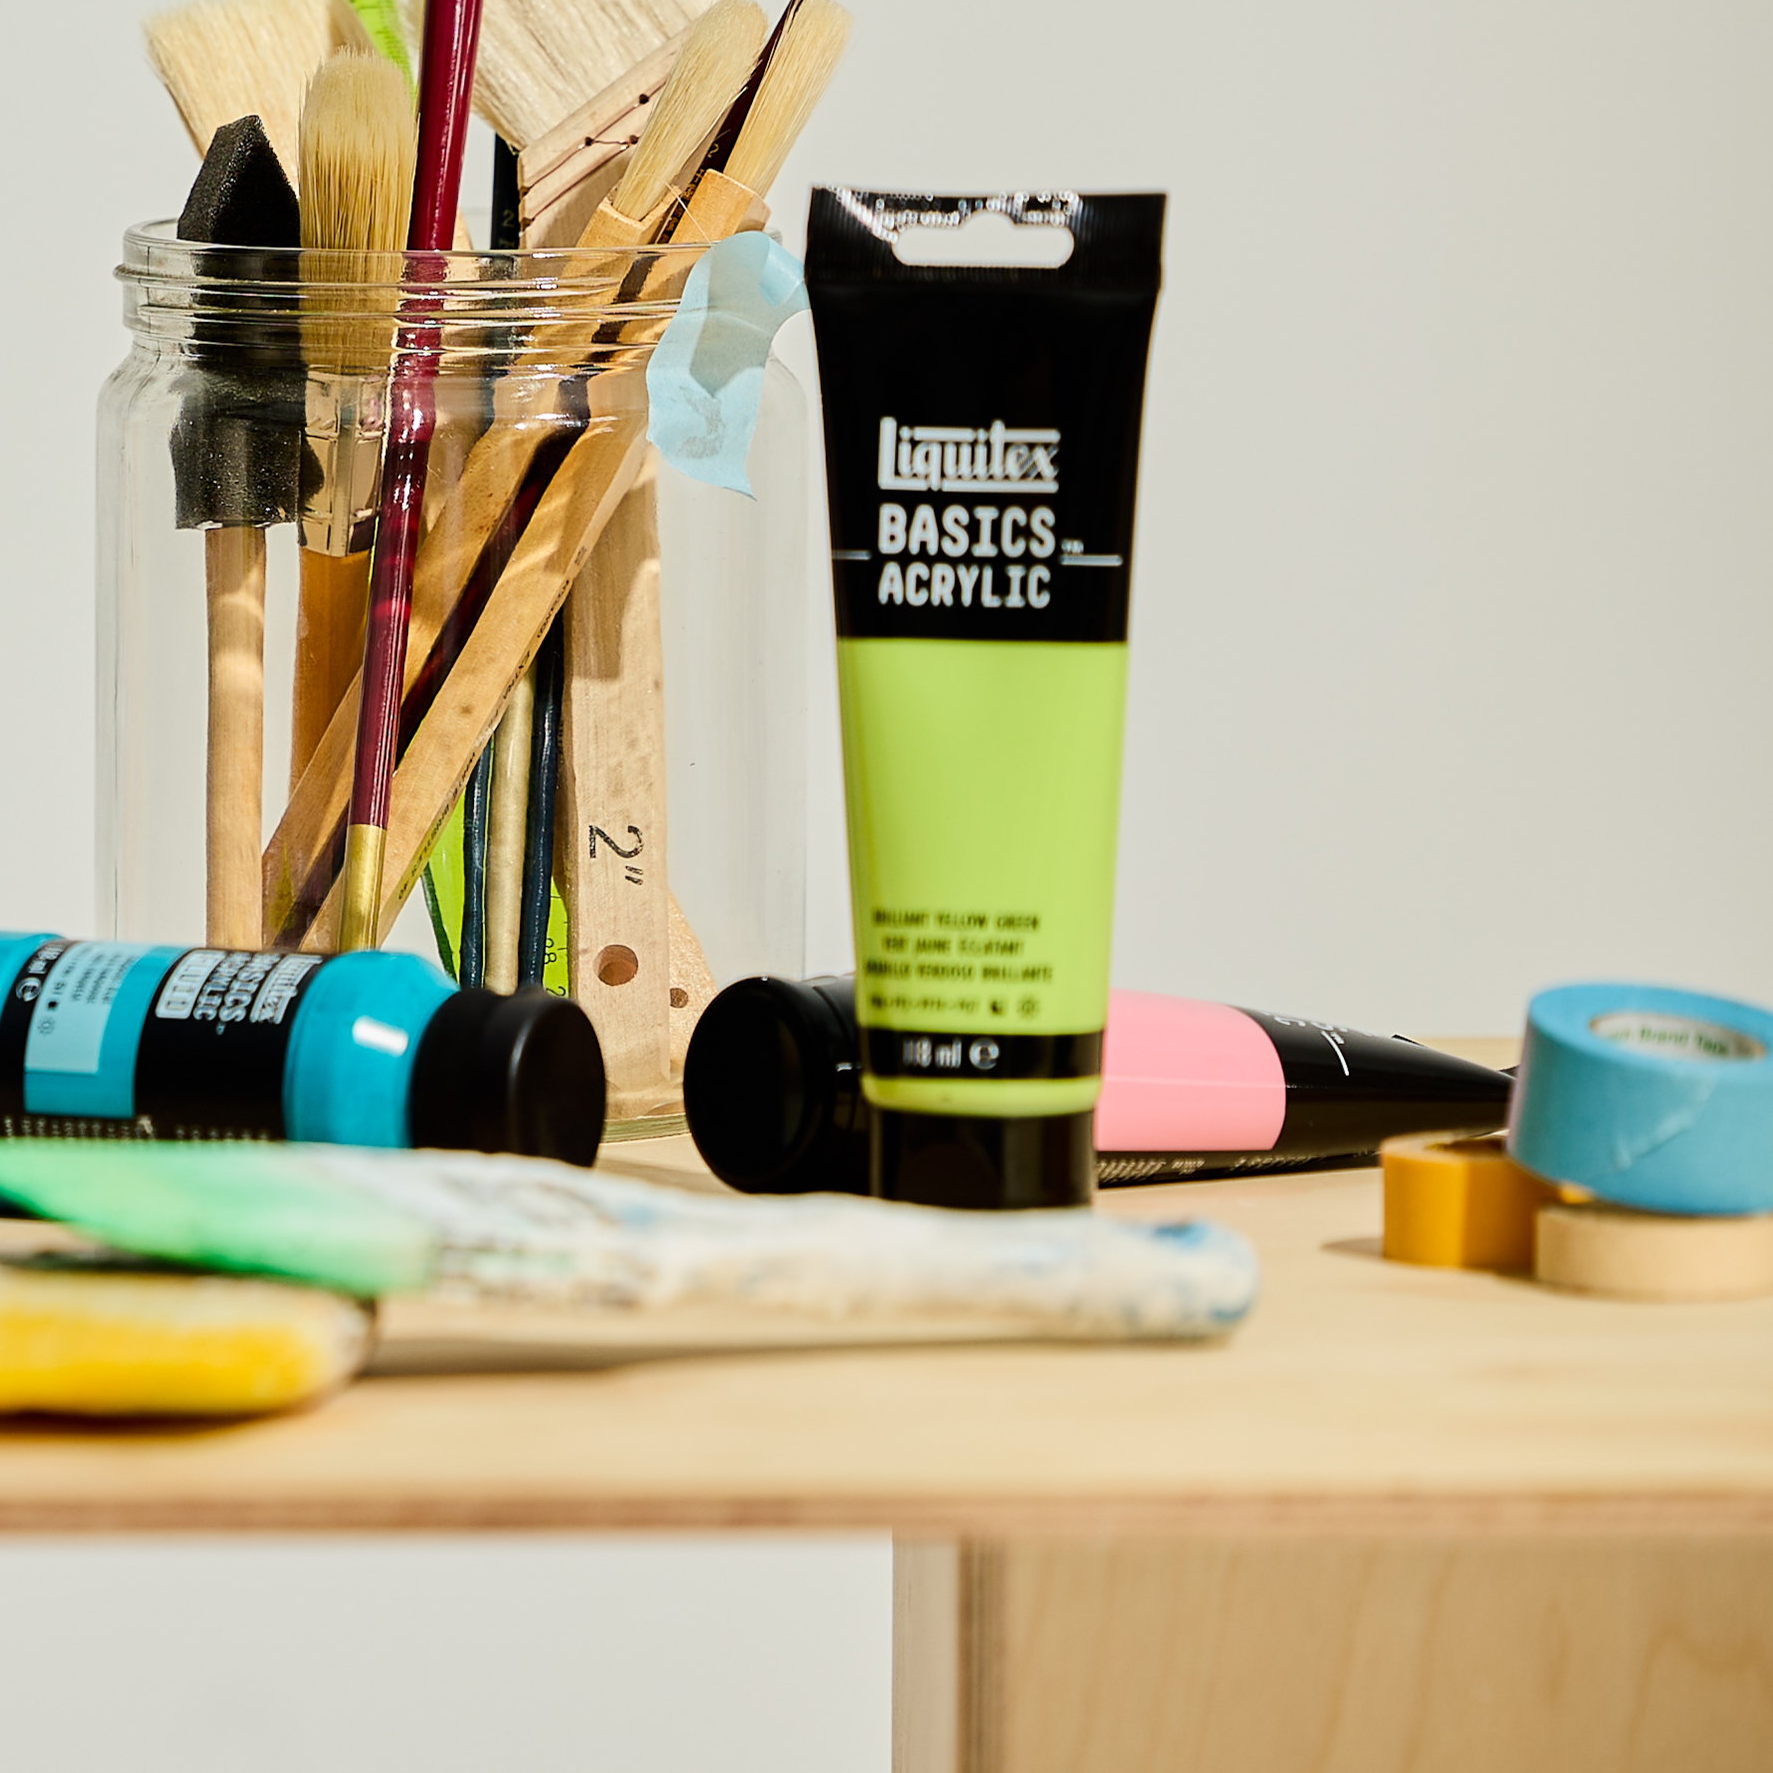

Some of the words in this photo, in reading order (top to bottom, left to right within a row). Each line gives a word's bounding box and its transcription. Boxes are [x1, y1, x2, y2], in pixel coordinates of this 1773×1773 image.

[877, 416, 1062, 494] Liquitex
[877, 502, 1057, 559] BASICS
[877, 561, 1053, 610] ACRYLIC
[588, 825, 644, 886] 2"
